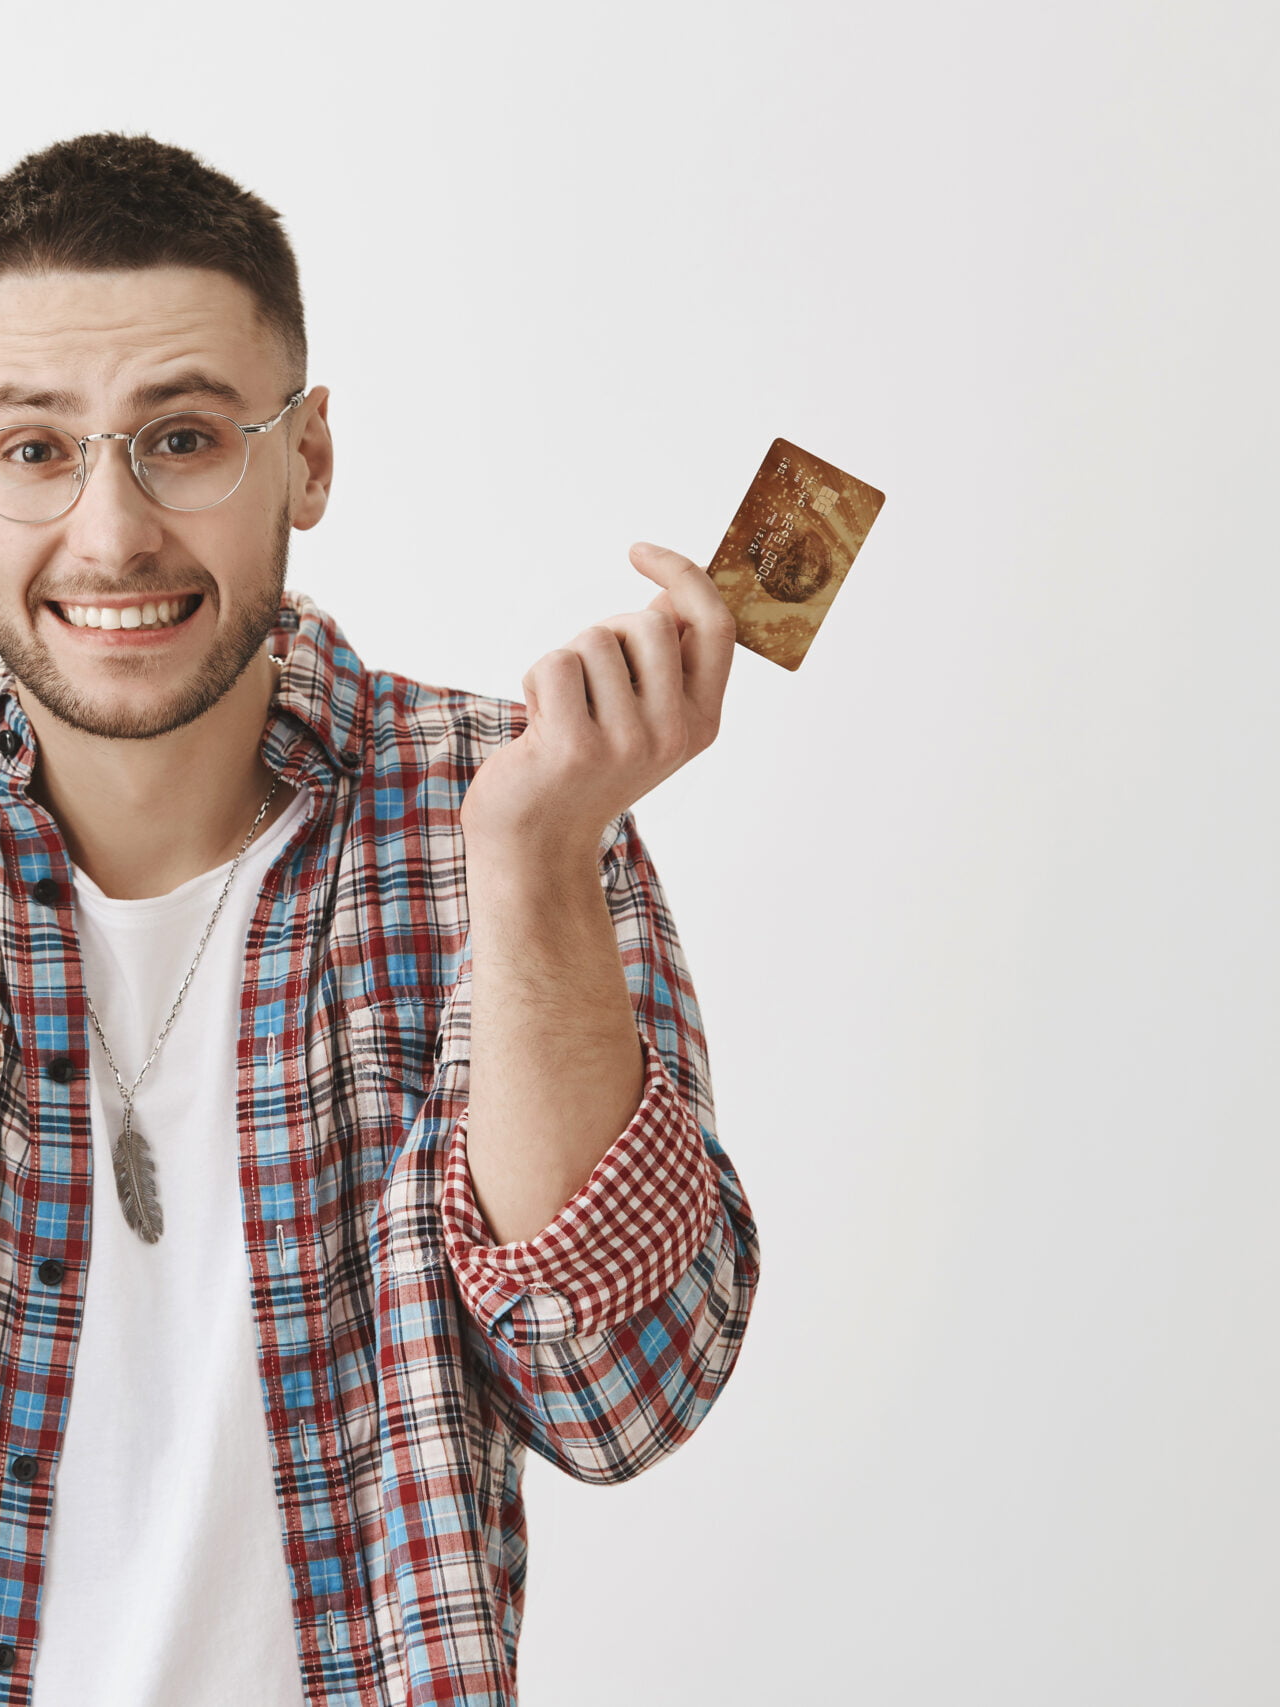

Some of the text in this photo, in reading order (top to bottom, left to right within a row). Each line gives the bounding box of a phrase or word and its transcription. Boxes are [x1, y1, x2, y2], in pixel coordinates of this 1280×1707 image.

[777, 456, 791, 475] USD
[748, 527, 766, 555] 12/20
[773, 512, 797, 546] 6293
[754, 550, 778, 583] 0006
